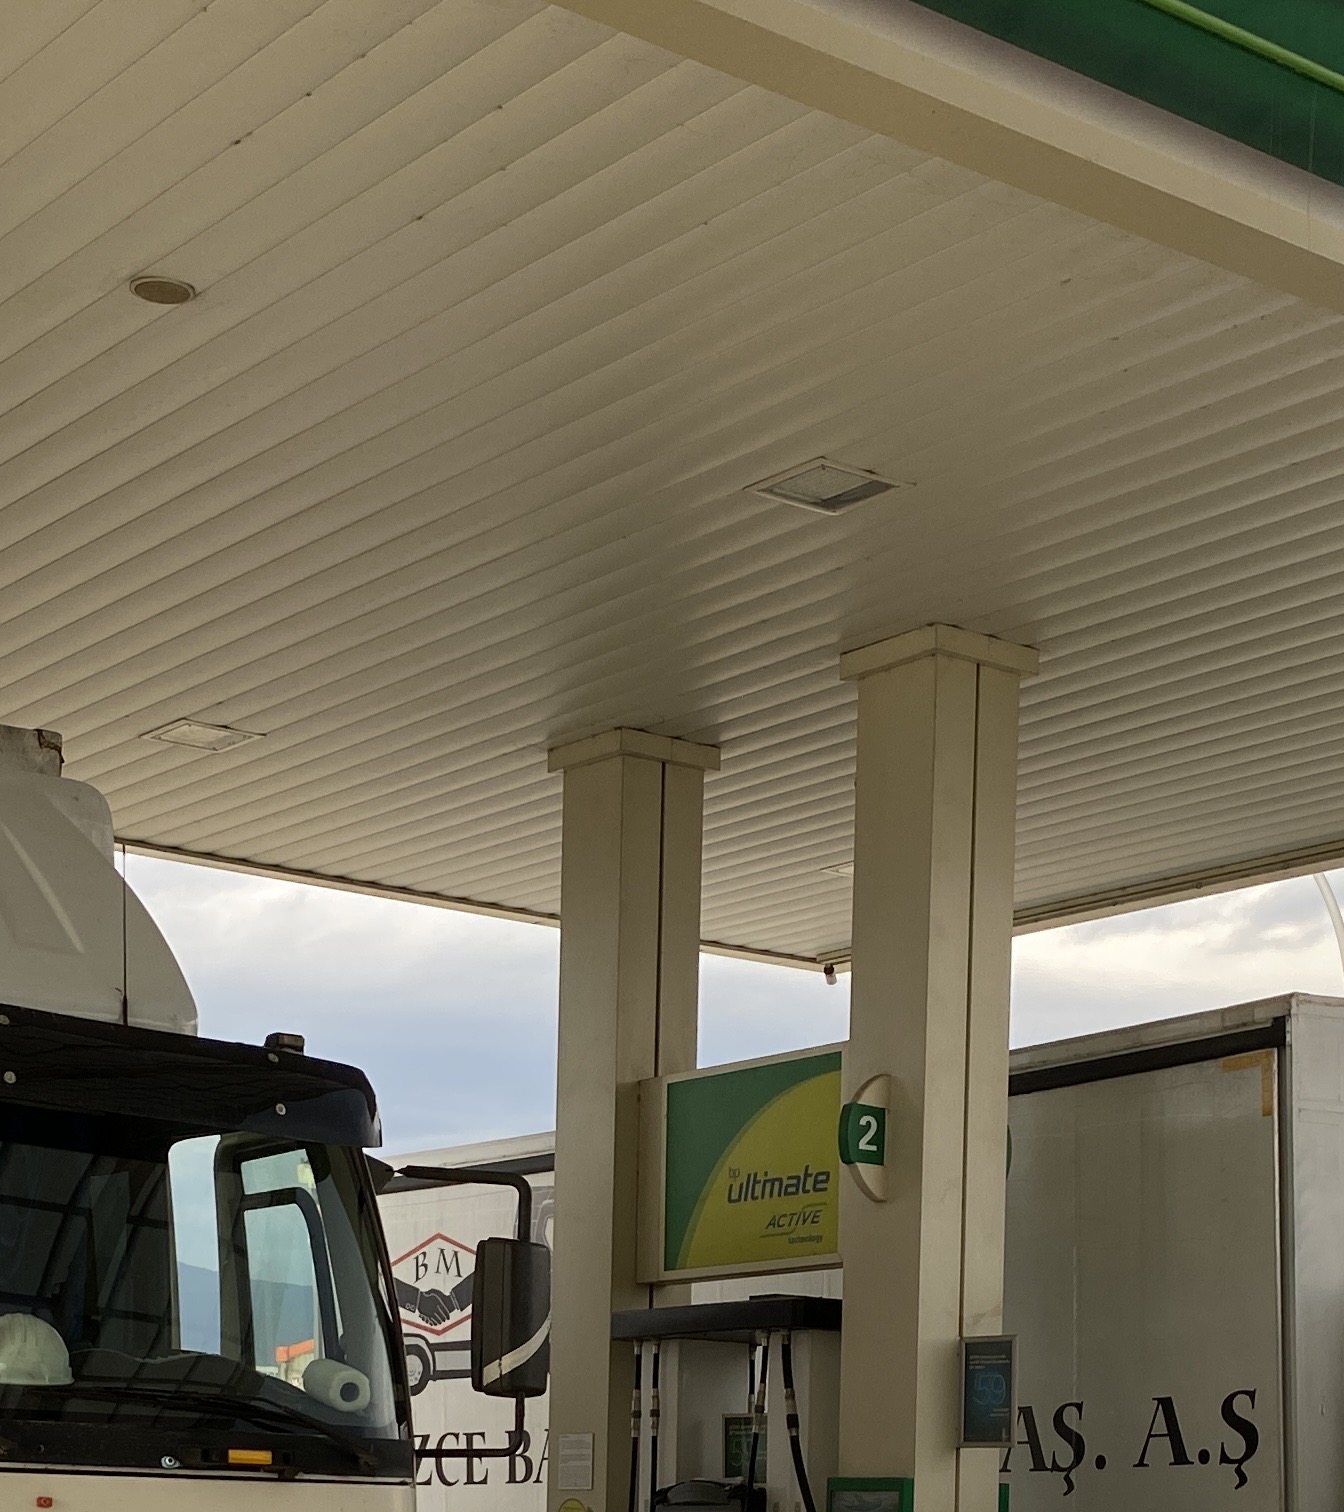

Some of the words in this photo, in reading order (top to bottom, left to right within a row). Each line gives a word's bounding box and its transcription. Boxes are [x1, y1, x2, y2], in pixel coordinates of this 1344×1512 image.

[858, 1115, 878, 1152] 2
[727, 1164, 831, 1204] ultimate
[765, 1209, 823, 1230] ACTIVE
[1133, 1388, 1260, 1490] A.Ş
